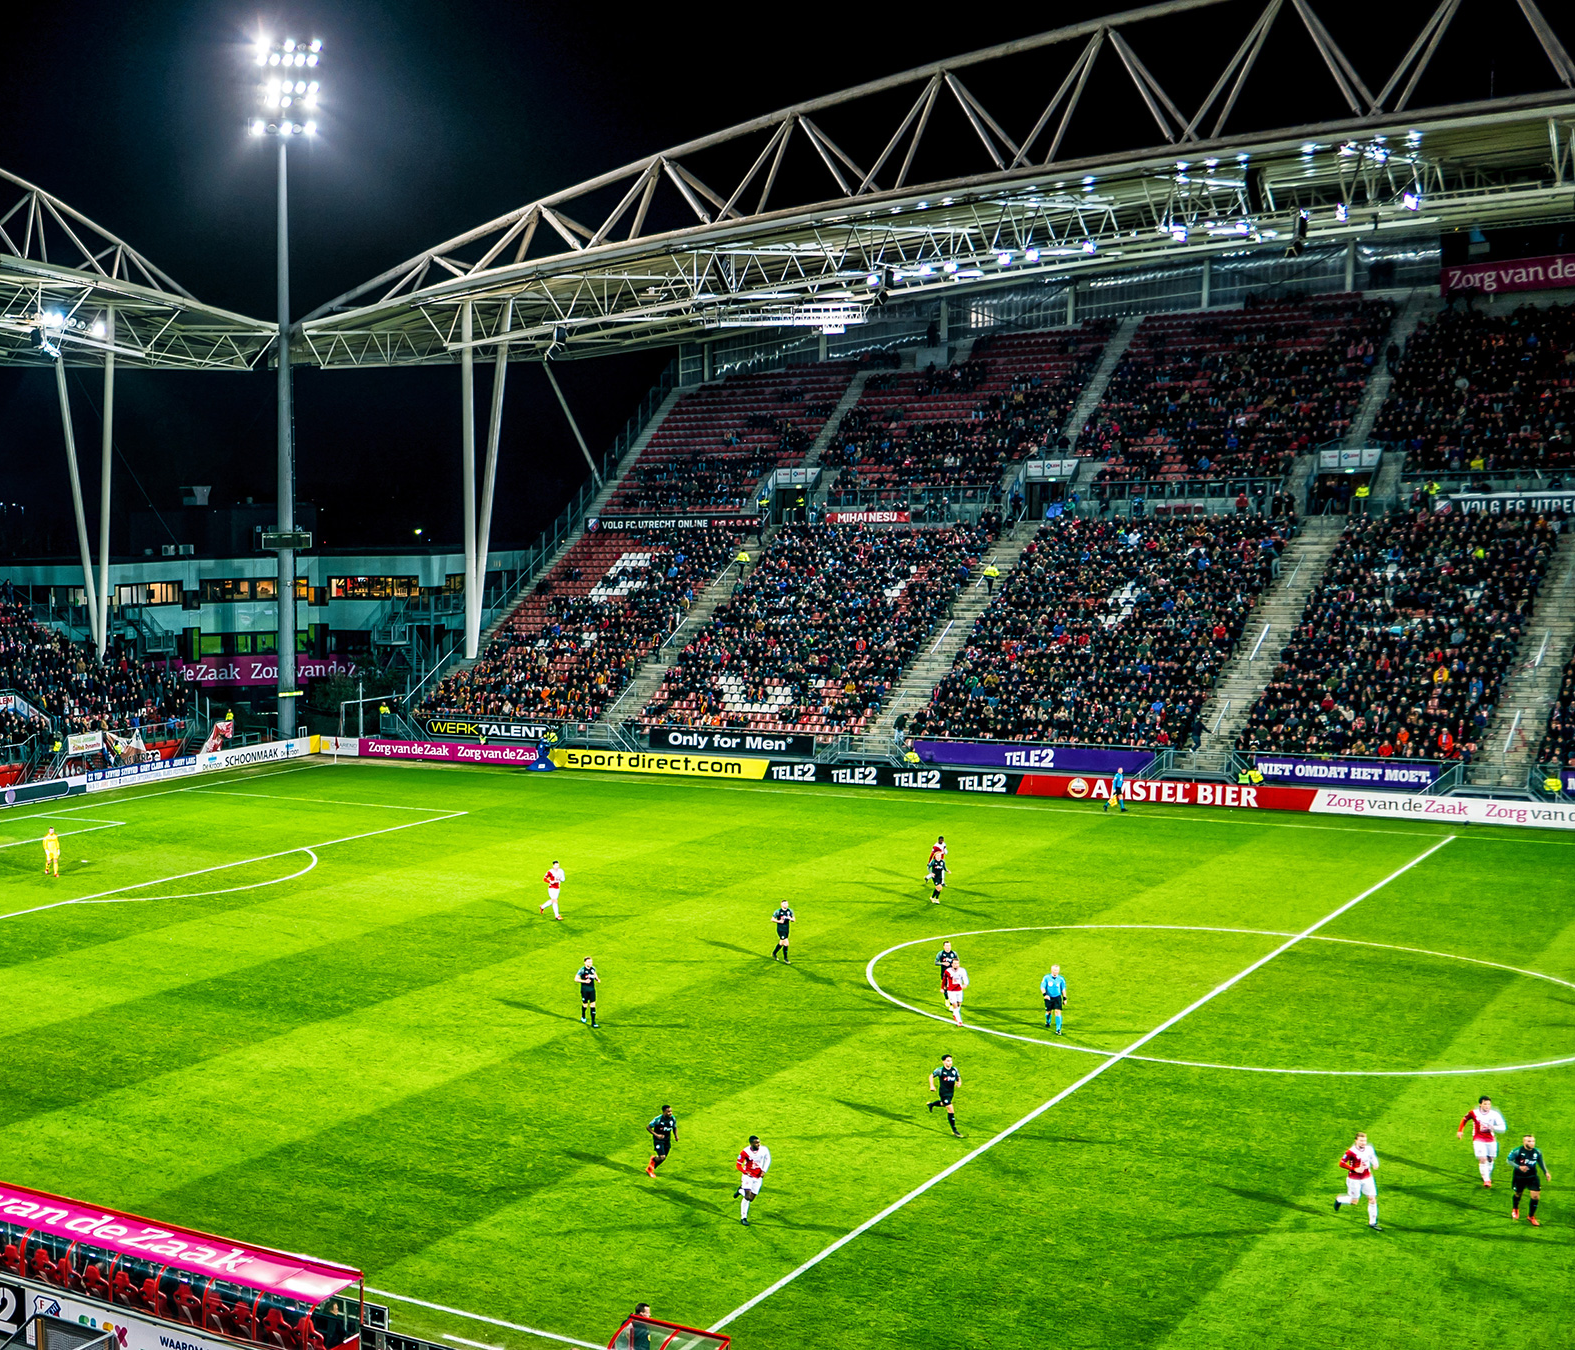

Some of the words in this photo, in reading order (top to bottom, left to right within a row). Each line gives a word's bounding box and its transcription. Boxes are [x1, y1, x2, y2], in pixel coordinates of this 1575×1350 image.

[1449, 270, 1497, 291] Zorg
[1500, 265, 1545, 284] van
[837, 512, 867, 523] MIHAI
[868, 512, 898, 522] NESU
[1461, 500, 1500, 516] VOLG
[1506, 500, 1526, 514] FC
[602, 520, 624, 530] VOLG
[638, 519, 676, 529] UTRECHT
[678, 519, 708, 528] ONLINE
[196, 663, 241, 681] Zaak
[251, 662, 279, 680] Zor
[297, 664, 326, 678] van
[368, 741, 392, 755] Zorg
[392, 745, 409, 754] van
[409, 743, 424, 755] de
[423, 744, 450, 757] Zaak
[668, 732, 704, 750] Only
[712, 734, 740, 748] for
[225, 748, 279, 767] SCHOONMAAK
[457, 746, 482, 761] Zorg
[482, 749, 502, 759] van
[502, 747, 516, 760] de
[1004, 748, 1055, 768] TELE2
[771, 763, 816, 782] TELE2
[831, 766, 878, 785] TELE2
[892, 770, 941, 789] TELE2
[1257, 762, 1293, 776] NIET
[1294, 764, 1349, 779] OMDAT
[1350, 767, 1382, 781] HET
[1384, 769, 1432, 784] MOET,
[957, 773, 1007, 792] TELE2
[1196, 784, 1259, 808] BIER
[1326, 793, 1365, 812] Zorg
[1367, 798, 1401, 811] van
[1402, 797, 1423, 813] de
[1424, 799, 1469, 816] Zaak
[1485, 803, 1528, 823] Zorg
[1530, 809, 1565, 822] van
[64, 1214, 128, 1240] de
[124, 1228, 255, 1273] Zaak
[39, 1299, 45, 1310] F
